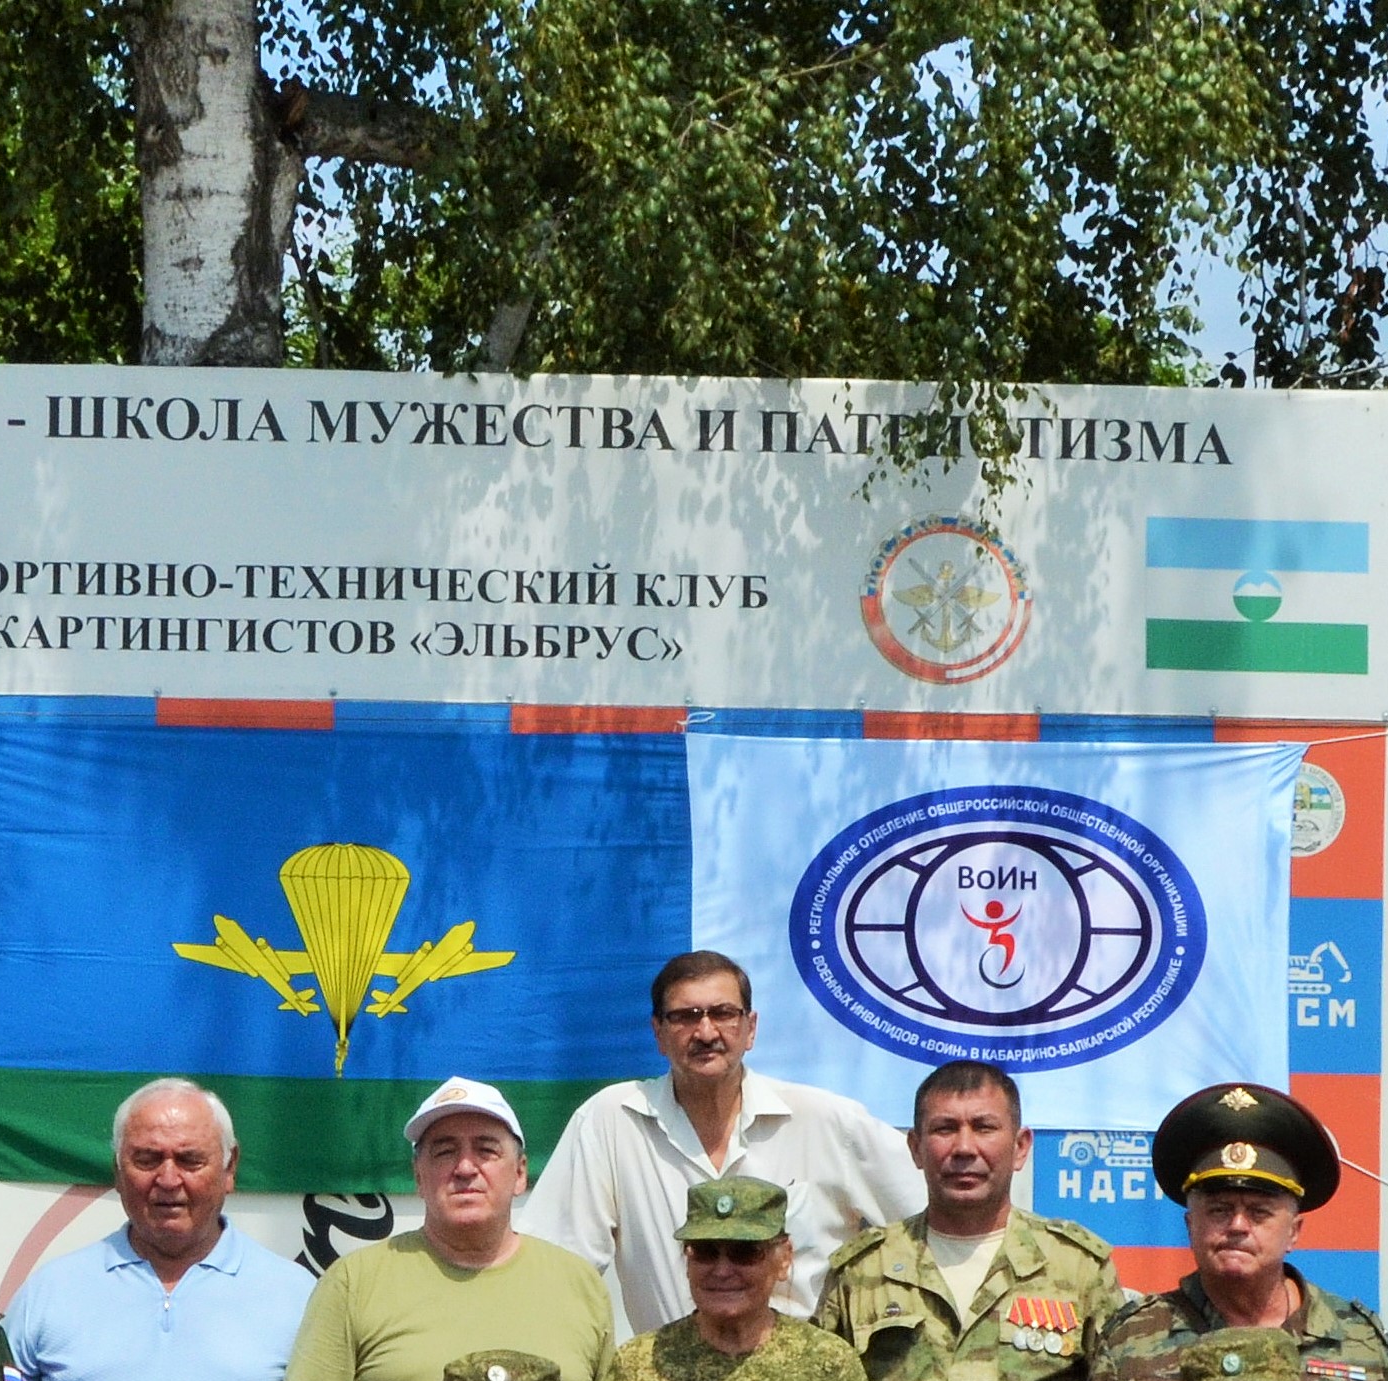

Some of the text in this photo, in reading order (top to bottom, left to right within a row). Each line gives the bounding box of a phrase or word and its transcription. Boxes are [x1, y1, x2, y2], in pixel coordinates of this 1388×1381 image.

[45, 395, 288, 443] ШКОЛА
[305, 400, 676, 452] МУЖЕСТВА
[696, 408, 740, 453] И
[759, 410, 1233, 465] ПАТРИТИЗМА
[632, 573, 769, 610] КЛУБ
[410, 623, 683, 663] «ЭЛЬБРУС»
[809, 797, 1188, 937] РЕГИОНАЛЬНОЕ ОТДЕЛЕНИЕ ОБЩЕРОССИЙСКОЙ ОБЩЕСТВЕННОЙ ОРГАНИЗАЦИИ
[957, 864, 1038, 891] ВоИн
[812, 955, 1183, 1062] ВОЕННЫХ ИНВАЛИДОВ «ВОИН» В КАБАРДИНО-БАЛКАРСКОЙ РЕСПУБЛИКЕ
[1058, 1169, 1164, 1203] НДС
